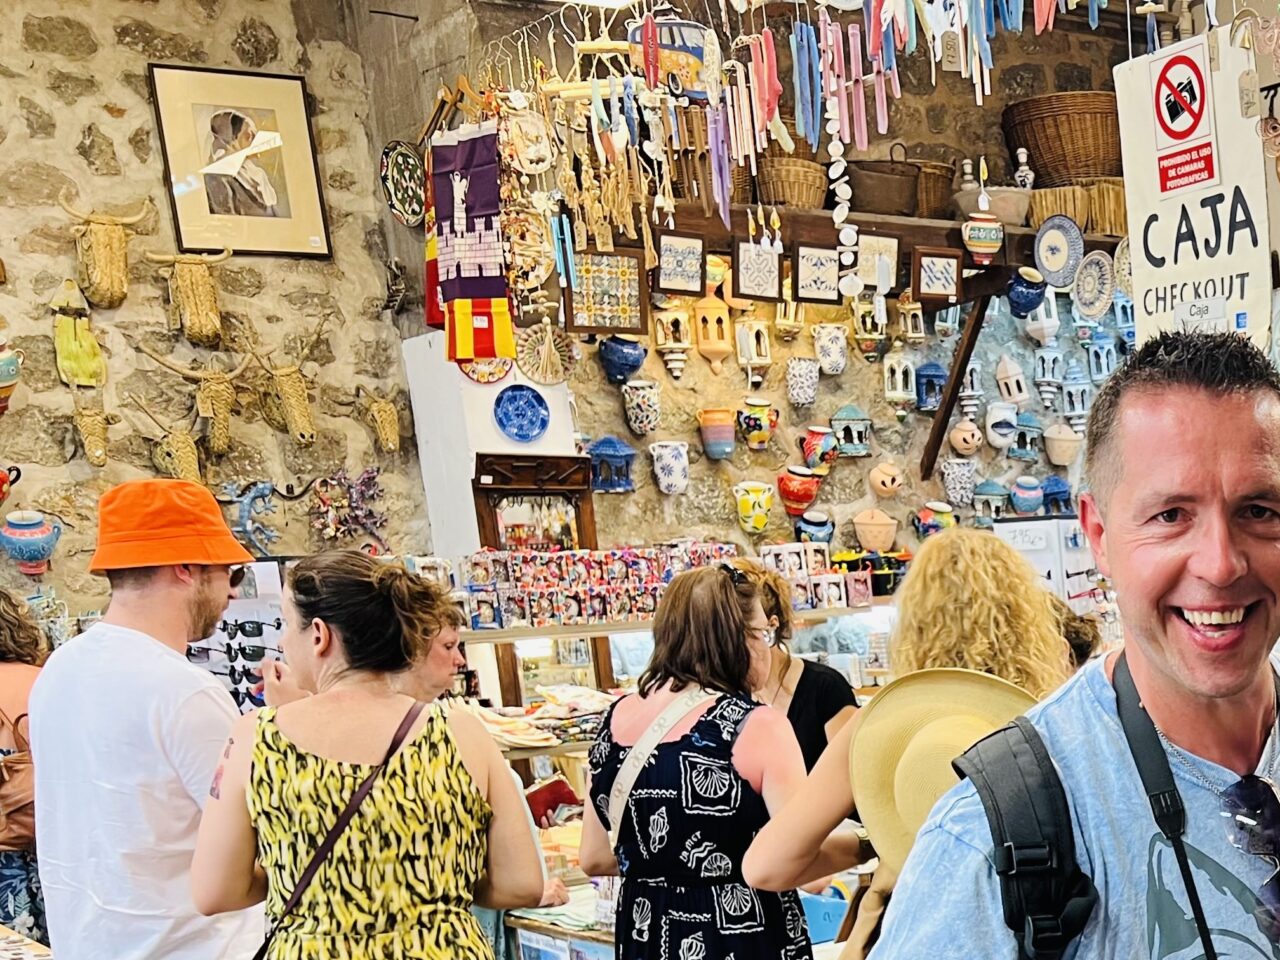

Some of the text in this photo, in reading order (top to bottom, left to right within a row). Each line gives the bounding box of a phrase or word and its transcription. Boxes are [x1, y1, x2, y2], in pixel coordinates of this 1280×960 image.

[1160, 146, 1212, 169] PROHIBIDO EL USO
[1168, 168, 1177, 178] DE
[1143, 185, 1258, 268] CAJA
[1144, 272, 1250, 316] CHECKOUT
[1189, 303, 1209, 319] Caja
